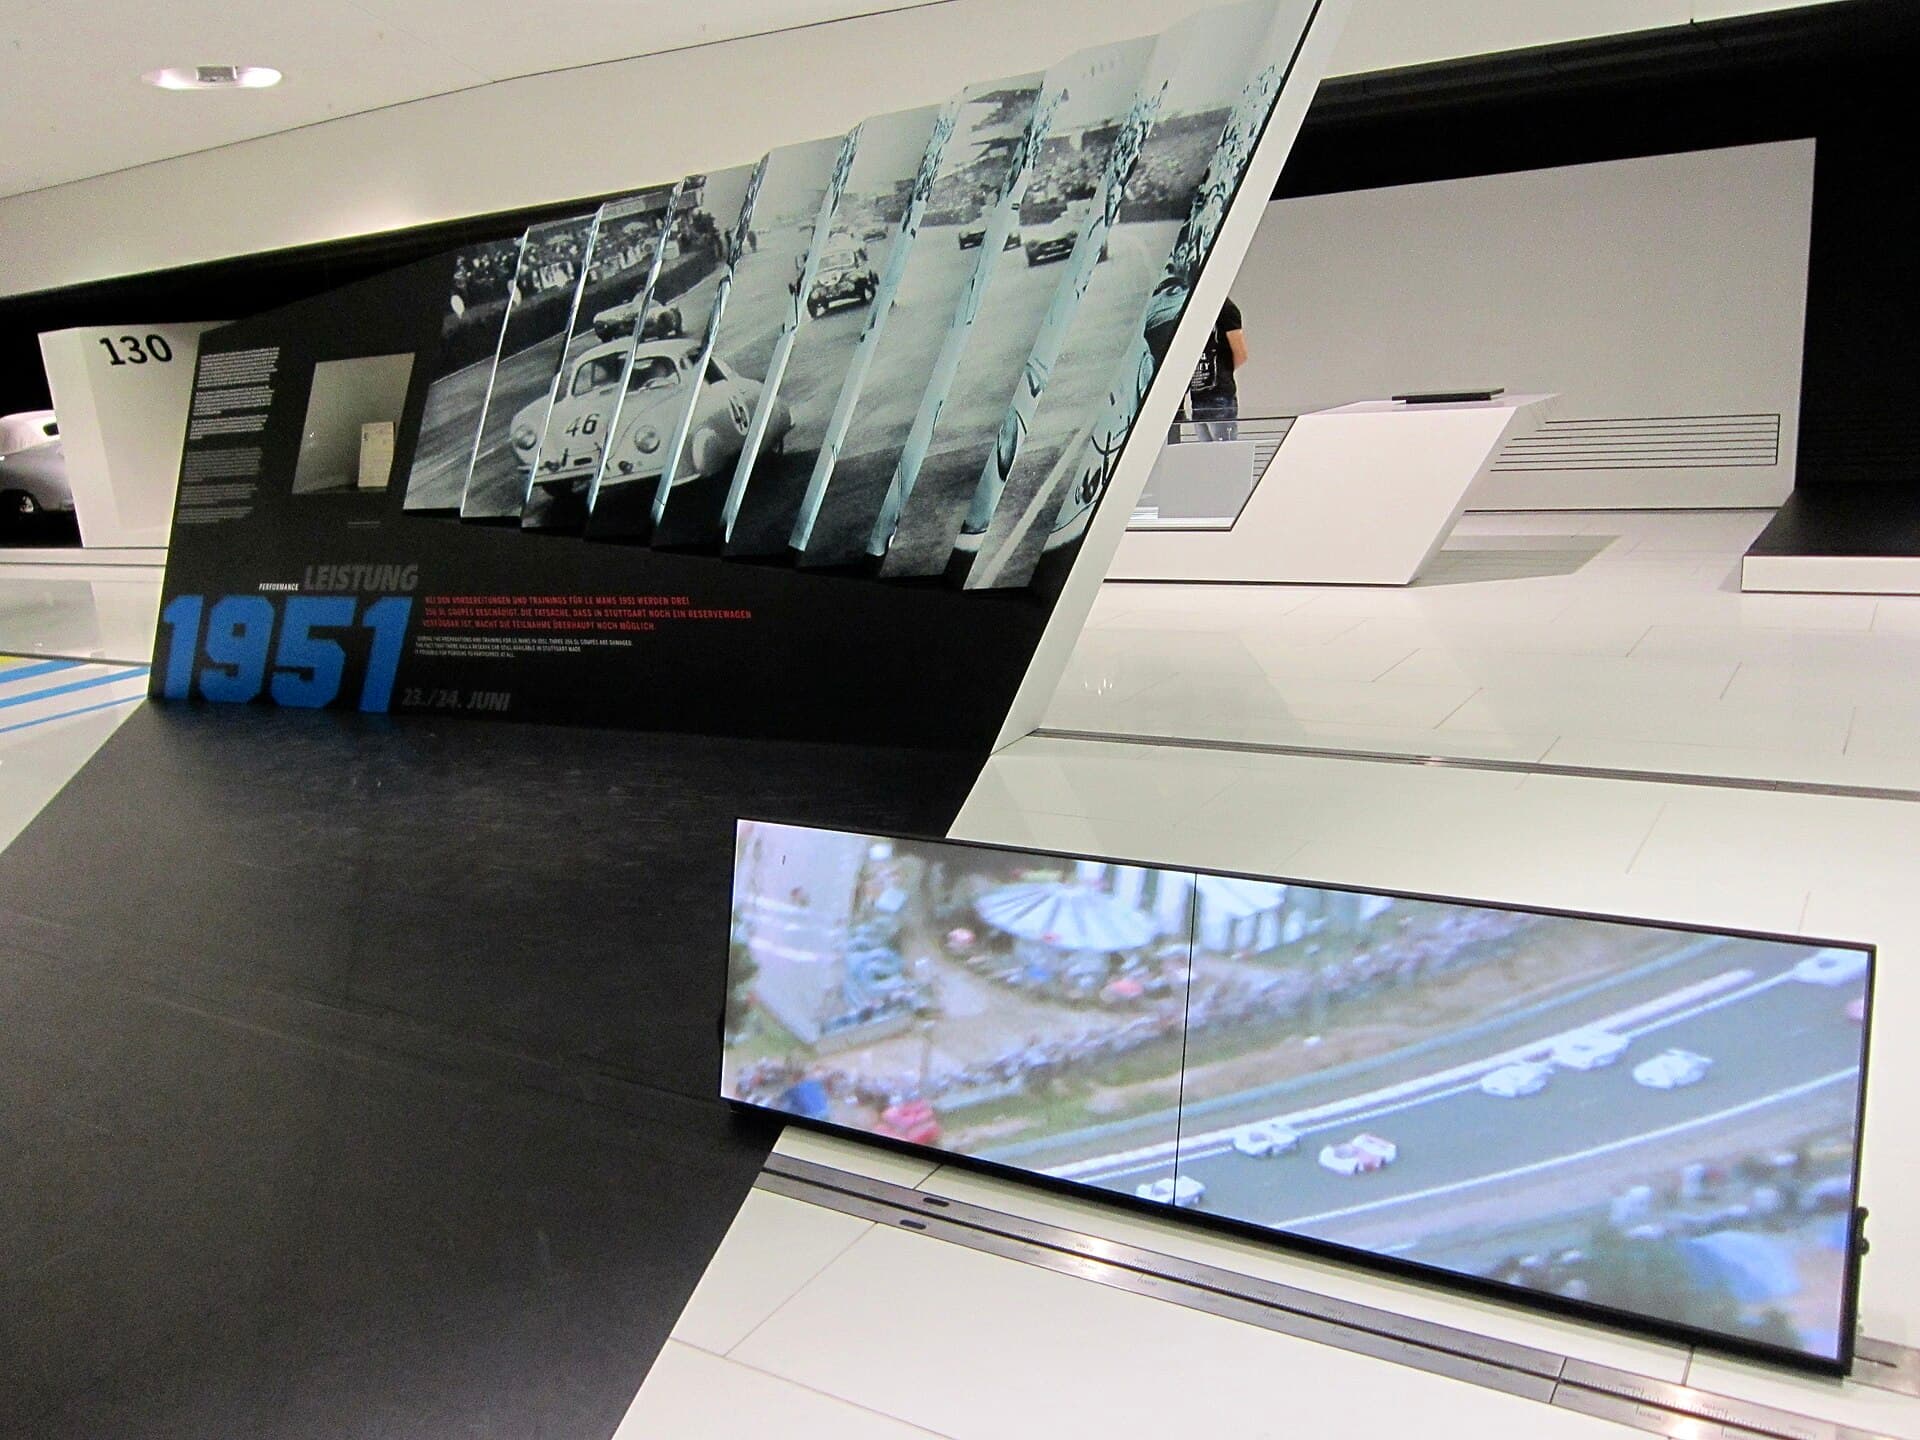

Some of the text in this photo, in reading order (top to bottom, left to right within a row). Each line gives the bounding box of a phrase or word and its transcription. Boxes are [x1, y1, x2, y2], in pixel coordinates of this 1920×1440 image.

[99, 333, 173, 366] 130
[565, 413, 600, 437] 46
[258, 563, 419, 592] PERFORMANCE LEISTUNG
[619, 597, 635, 605] 1951
[638, 597, 669, 605] WERDEN
[671, 597, 690, 605] DREI
[573, 609, 592, 617] DASS
[604, 609, 646, 618] STUTTGART
[649, 609, 671, 618] NOCH
[673, 609, 686, 618] EIN
[688, 609, 752, 618] RESERVEWAGEN
[597, 621, 618, 629] NOCH
[163, 595, 413, 713] 1951
[466, 690, 512, 712] JUNI
